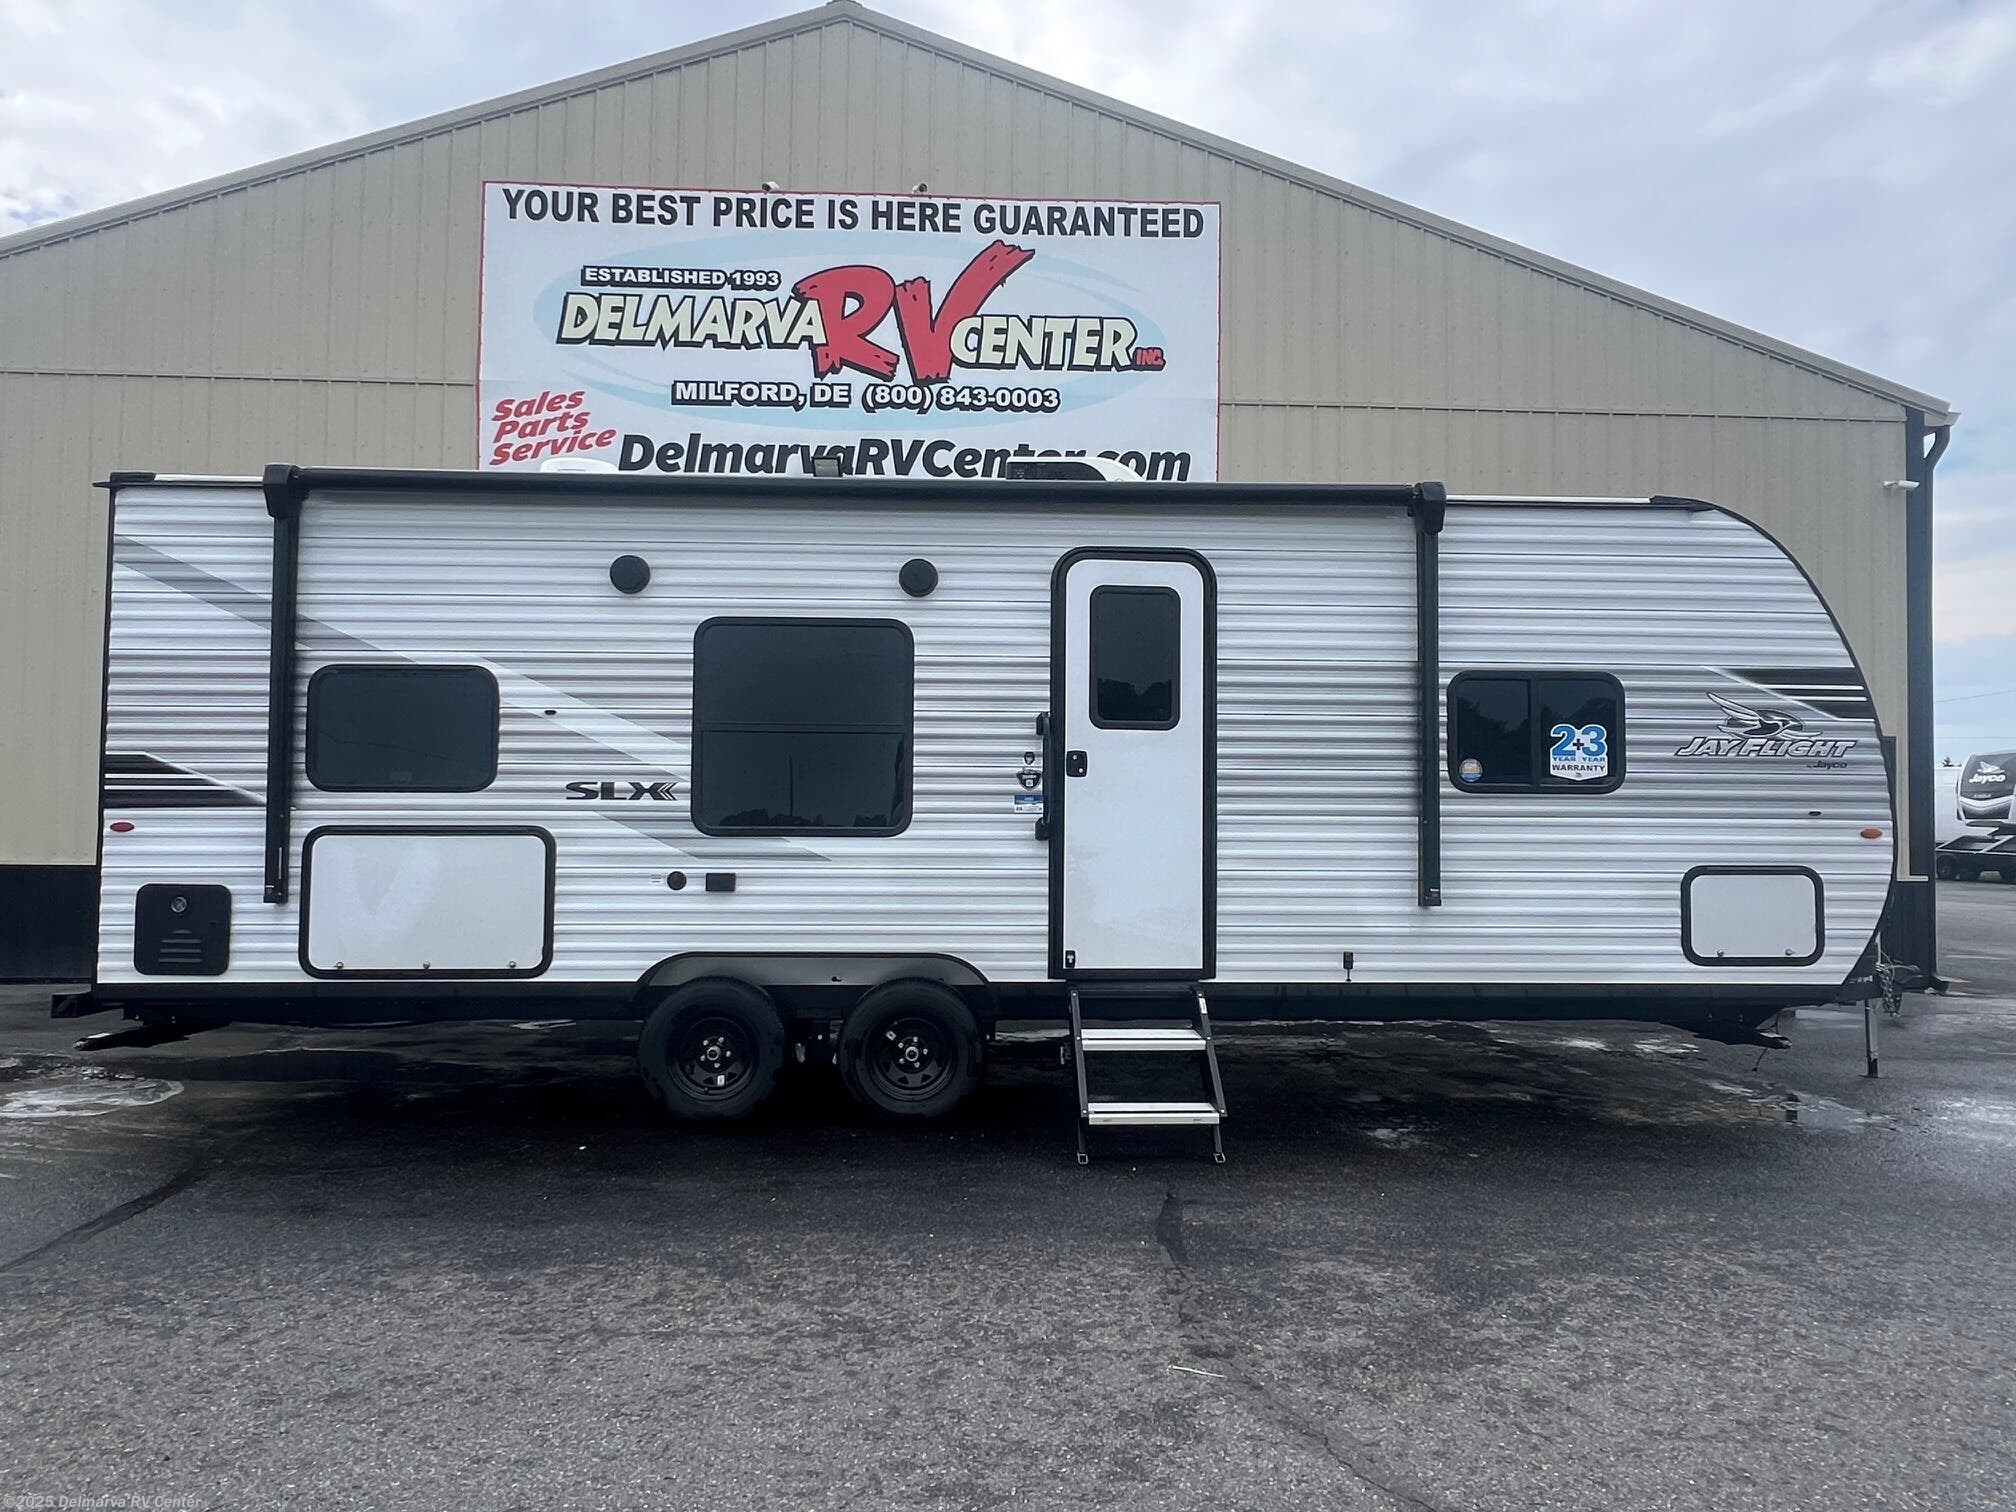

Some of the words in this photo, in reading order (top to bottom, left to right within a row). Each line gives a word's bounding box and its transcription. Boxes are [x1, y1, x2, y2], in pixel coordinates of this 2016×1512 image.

[502, 188, 599, 223] YOUR
[612, 193, 701, 226] BEST
[713, 196, 815, 229] PRICE
[828, 199, 859, 230] IS
[871, 200, 962, 233] HERE
[973, 204, 1204, 238] GUARANTEED
[583, 266, 728, 289] ESTABLISHED
[731, 271, 782, 291] 1993
[557, 292, 827, 350] DELMARVA
[792, 239, 1035, 385] RV
[950, 314, 1137, 371] CENTER
[492, 390, 585, 421] Sales
[673, 381, 806, 411] MILFORD,
[810, 383, 851, 408] DE
[863, 384, 932, 413] (800)
[939, 386, 1060, 412] 843-0003
[493, 410, 590, 443] Parts
[1674, 737, 1740, 757] JAY
[1739, 738, 1858, 757] FLIGHT
[1552, 764, 1606, 772] WARRANTY
